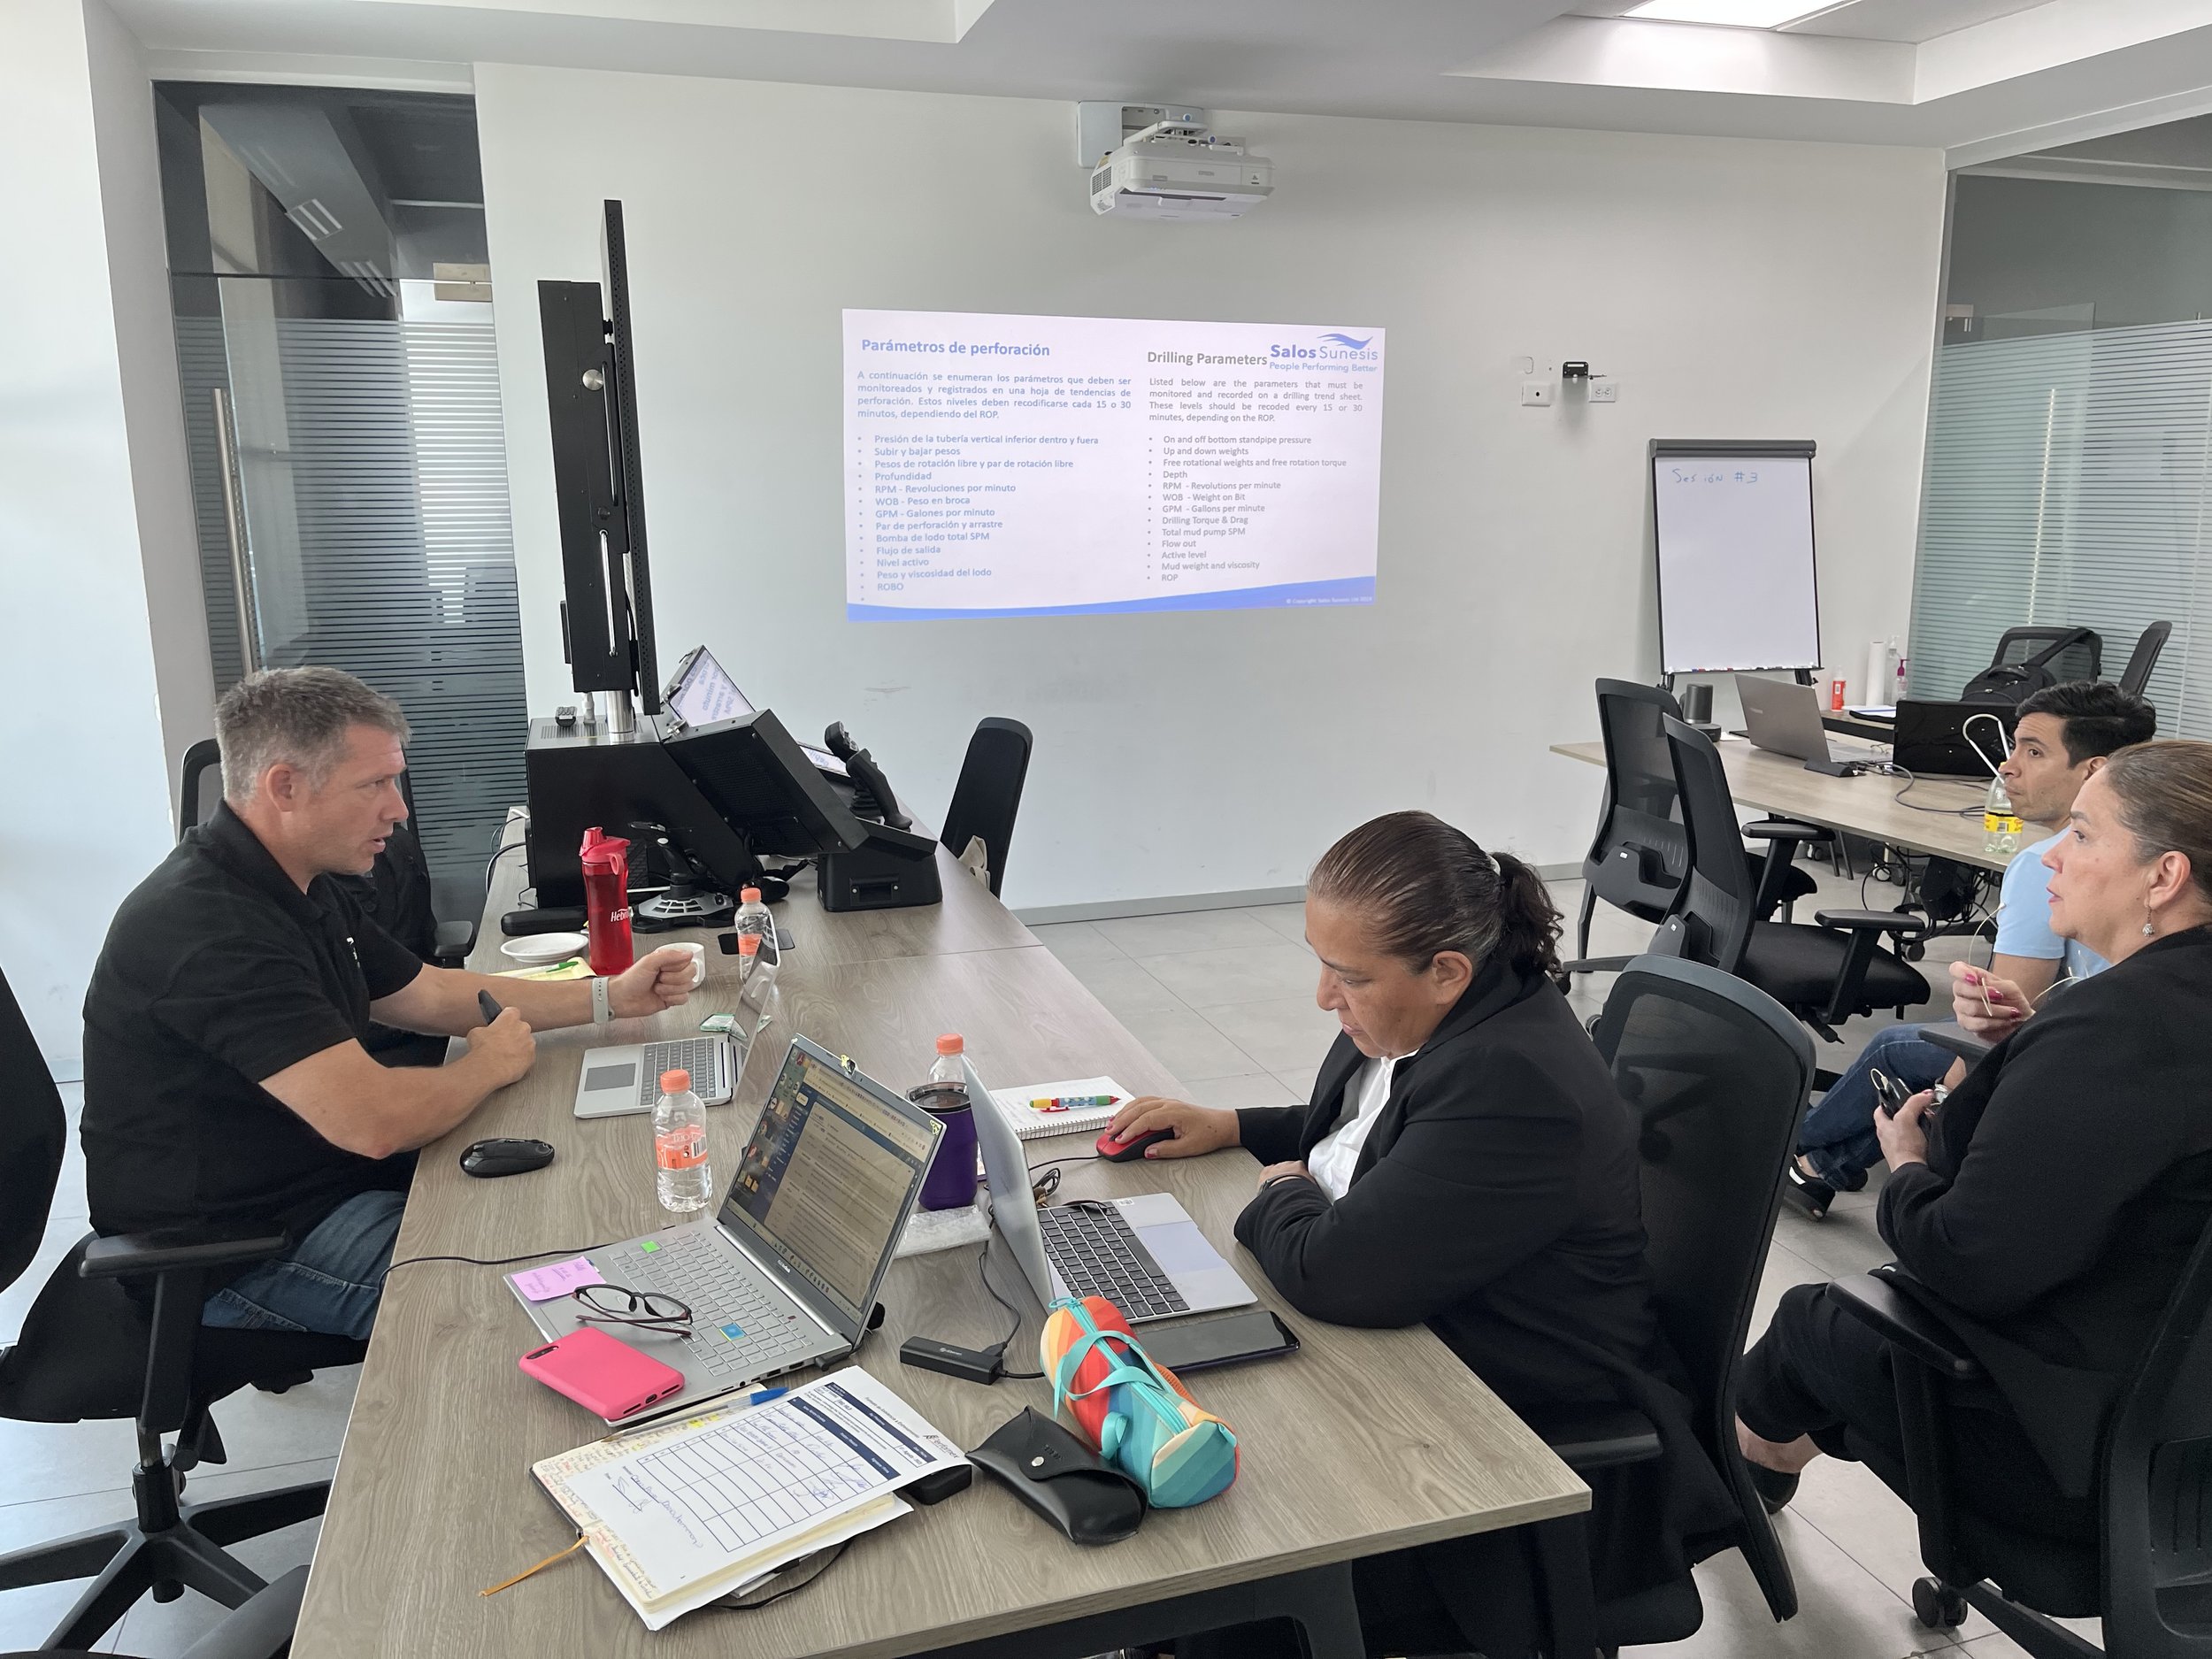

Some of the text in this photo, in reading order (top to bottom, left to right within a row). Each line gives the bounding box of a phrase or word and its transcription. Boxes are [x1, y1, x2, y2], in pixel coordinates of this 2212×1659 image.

[862, 339, 1049, 357] Parámetros de perforación
[1270, 345, 1378, 360] Salos Sunesis
[1147, 351, 1267, 365] Drilling Parameters
[1269, 361, 1300, 372] People
[1302, 362, 1348, 373] Performing
[868, 371, 928, 380] continuación
[1013, 374, 1063, 384] parámetros
[857, 383, 922, 392] monitoreados
[938, 385, 987, 396] registrados
[1030, 387, 1048, 396] hoja
[857, 396, 913, 406] perforación.
[1283, 391, 1310, 401] drilling
[857, 410, 897, 419] minutos,
[900, 409, 961, 419] dependiendo
[1186, 413, 1229, 422] depending
[909, 447, 933, 457] bajar
[1163, 447, 1175, 456] Up
[1223, 458, 1254, 467] weights
[874, 472, 932, 480] Profundidad
[906, 520, 959, 531] perforación
[1162, 517, 1190, 526] Drilling
[1192, 516, 1219, 525] Torque
[1230, 516, 1248, 525] Drag
[876, 534, 908, 542] Bomba
[876, 547, 900, 556] Flujo
[877, 582, 904, 591] ROBO
